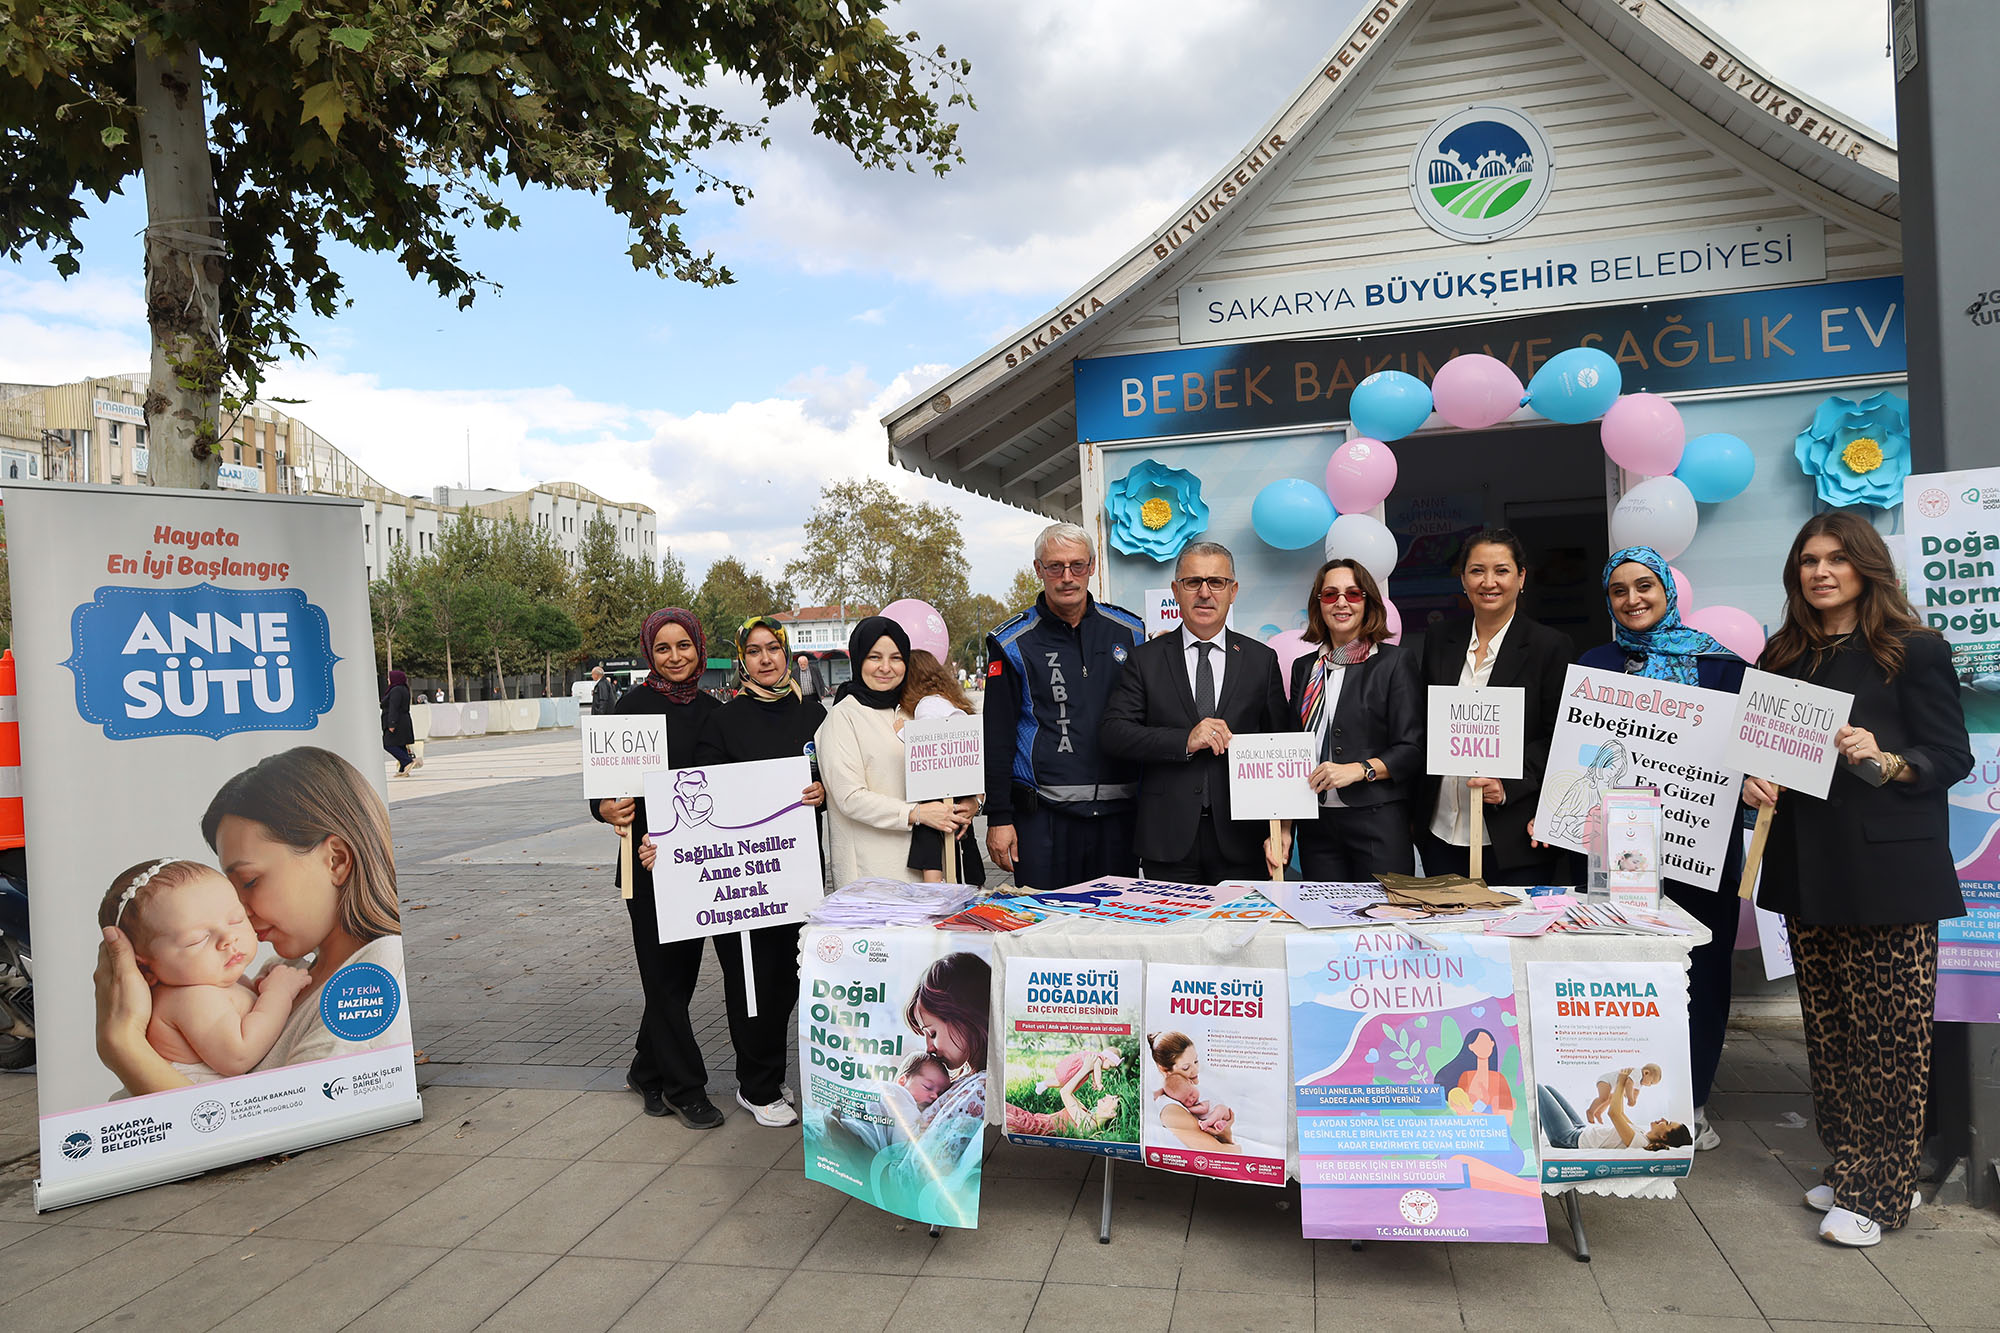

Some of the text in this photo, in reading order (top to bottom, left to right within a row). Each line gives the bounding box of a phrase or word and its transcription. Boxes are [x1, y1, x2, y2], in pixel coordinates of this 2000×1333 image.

[1700, 50, 1865, 161] BÜYÜKŞEHİR
[1153, 133, 1287, 260] BÜYÜKŞEHİR
[1208, 233, 1794, 324] SAKARYA BÜYÜKŞEHİR BELEDİYESİ
[1005, 296, 1104, 369] SAKARYA
[1121, 364, 1273, 418] BEBEK
[1821, 302, 1907, 352] EV
[153, 525, 240, 550] Hayata
[107, 550, 290, 581] En İyi Başlangıç
[1923, 558, 1995, 581] Olan
[121, 610, 291, 655] ANNE
[1955, 643, 1984, 652] olarak
[122, 655, 295, 719] SÜTÜ
[1045, 652, 1074, 753] ZABITA
[1450, 701, 1500, 722] MUCİZE
[1570, 675, 1705, 727] Anneler;
[1746, 690, 1834, 732] ANNE SÜTÜ
[1450, 722, 1500, 735] SÜTÜNÜZDE
[1566, 706, 1679, 745] Bebeğinize
[1743, 711, 1829, 745] ANNE BEBEK BAĞINI
[589, 728, 617, 754] İLK
[911, 737, 980, 759] ANNE SÜTÜNÜ
[1450, 736, 1500, 758] SAKLI
[1738, 724, 1824, 764] GÜÇLENDİRİR
[591, 753, 661, 767] SADECE ANNE SÜTÜ
[910, 753, 980, 773] DESTEKLİYORUZ
[1237, 758, 1312, 779] ANNE SÜTÜ
[1631, 751, 1730, 787] Vereceğiniz
[1663, 777, 1716, 807] Güzel
[1661, 804, 1711, 829] ediye
[673, 835, 797, 865] Sağlıklı Nesiller
[698, 858, 781, 883] Anne Sütü
[1660, 852, 1716, 877] tüdür
[713, 881, 769, 902] Alarak
[696, 901, 789, 926] Oluşacaktır
[1962, 930, 1995, 939] KADAR
[1939, 947, 1993, 958] HER BEBEK
[1941, 957, 1970, 967] KENDİ
[1028, 969, 1119, 987] ANNE SÜTÜ
[1328, 956, 1464, 982] SÜTÜNÜN
[342, 984, 381, 996] 1-7 EKİM
[812, 979, 886, 1007] Doğal
[1027, 985, 1119, 1005] DOĞADAKİ
[1171, 978, 1264, 997] ANNE SÜTÜ
[1350, 982, 1443, 1009] ÖNEMİ
[1555, 978, 1658, 998] BİR DAMLA
[337, 996, 384, 1009] EMZİRME
[1027, 1004, 1119, 1016] EN ÇEVRECİ BESİNDİR
[1170, 995, 1263, 1019] MUCİZESİ
[1557, 997, 1660, 1017] BİN FAYDA
[338, 1008, 382, 1020] HAFTASI
[811, 1003, 870, 1028] Olan
[810, 1025, 903, 1056] Normal
[352, 1065, 403, 1082] SAĞLIK İŞLERİ
[811, 1047, 898, 1081] Doğum
[352, 1077, 382, 1089] DAİRESİ
[353, 1081, 395, 1096] BAŞKANLIĞI
[1300, 1086, 1440, 1095] SEVGİLİ ANNELER, BEBEĞİNİZE İLK 6 AY
[230, 1086, 306, 1108] T.C. SAĞLIK BAKANLIĞI
[850, 1088, 880, 1101] zorunlu
[1319, 1095, 1420, 1104] SADECE ANNE SÜTÜ VERİNİZ
[231, 1103, 261, 1115] SAKARYA
[239, 1108, 262, 1119] SAĞLIK
[101, 1116, 155, 1134] SAKARYA
[101, 1121, 173, 1145] BÜYÜKŞEHİR
[1304, 1129, 1507, 1138] BESİNLERLE BİRLİKTE EN AZ 2 YAŞ VE ÖTESİNE
[1312, 1118, 1488, 1128] 6.AYDAN SONRA İSE UYGUN TAMAMLAYICI
[102, 1131, 166, 1154] BELEDİYESİ
[1338, 1140, 1485, 1149] KADAR EMZİRMEYE DEVAM EDİNİZ
[1316, 1161, 1447, 1170] HER BEBEK İÇİN EN İYİ BESİN
[1319, 1171, 1446, 1181] KENDİ ANNESİNİN SÜTÜDÜR
[1376, 1225, 1469, 1238] T.C. SAĞLIK BAKANLIĞI
